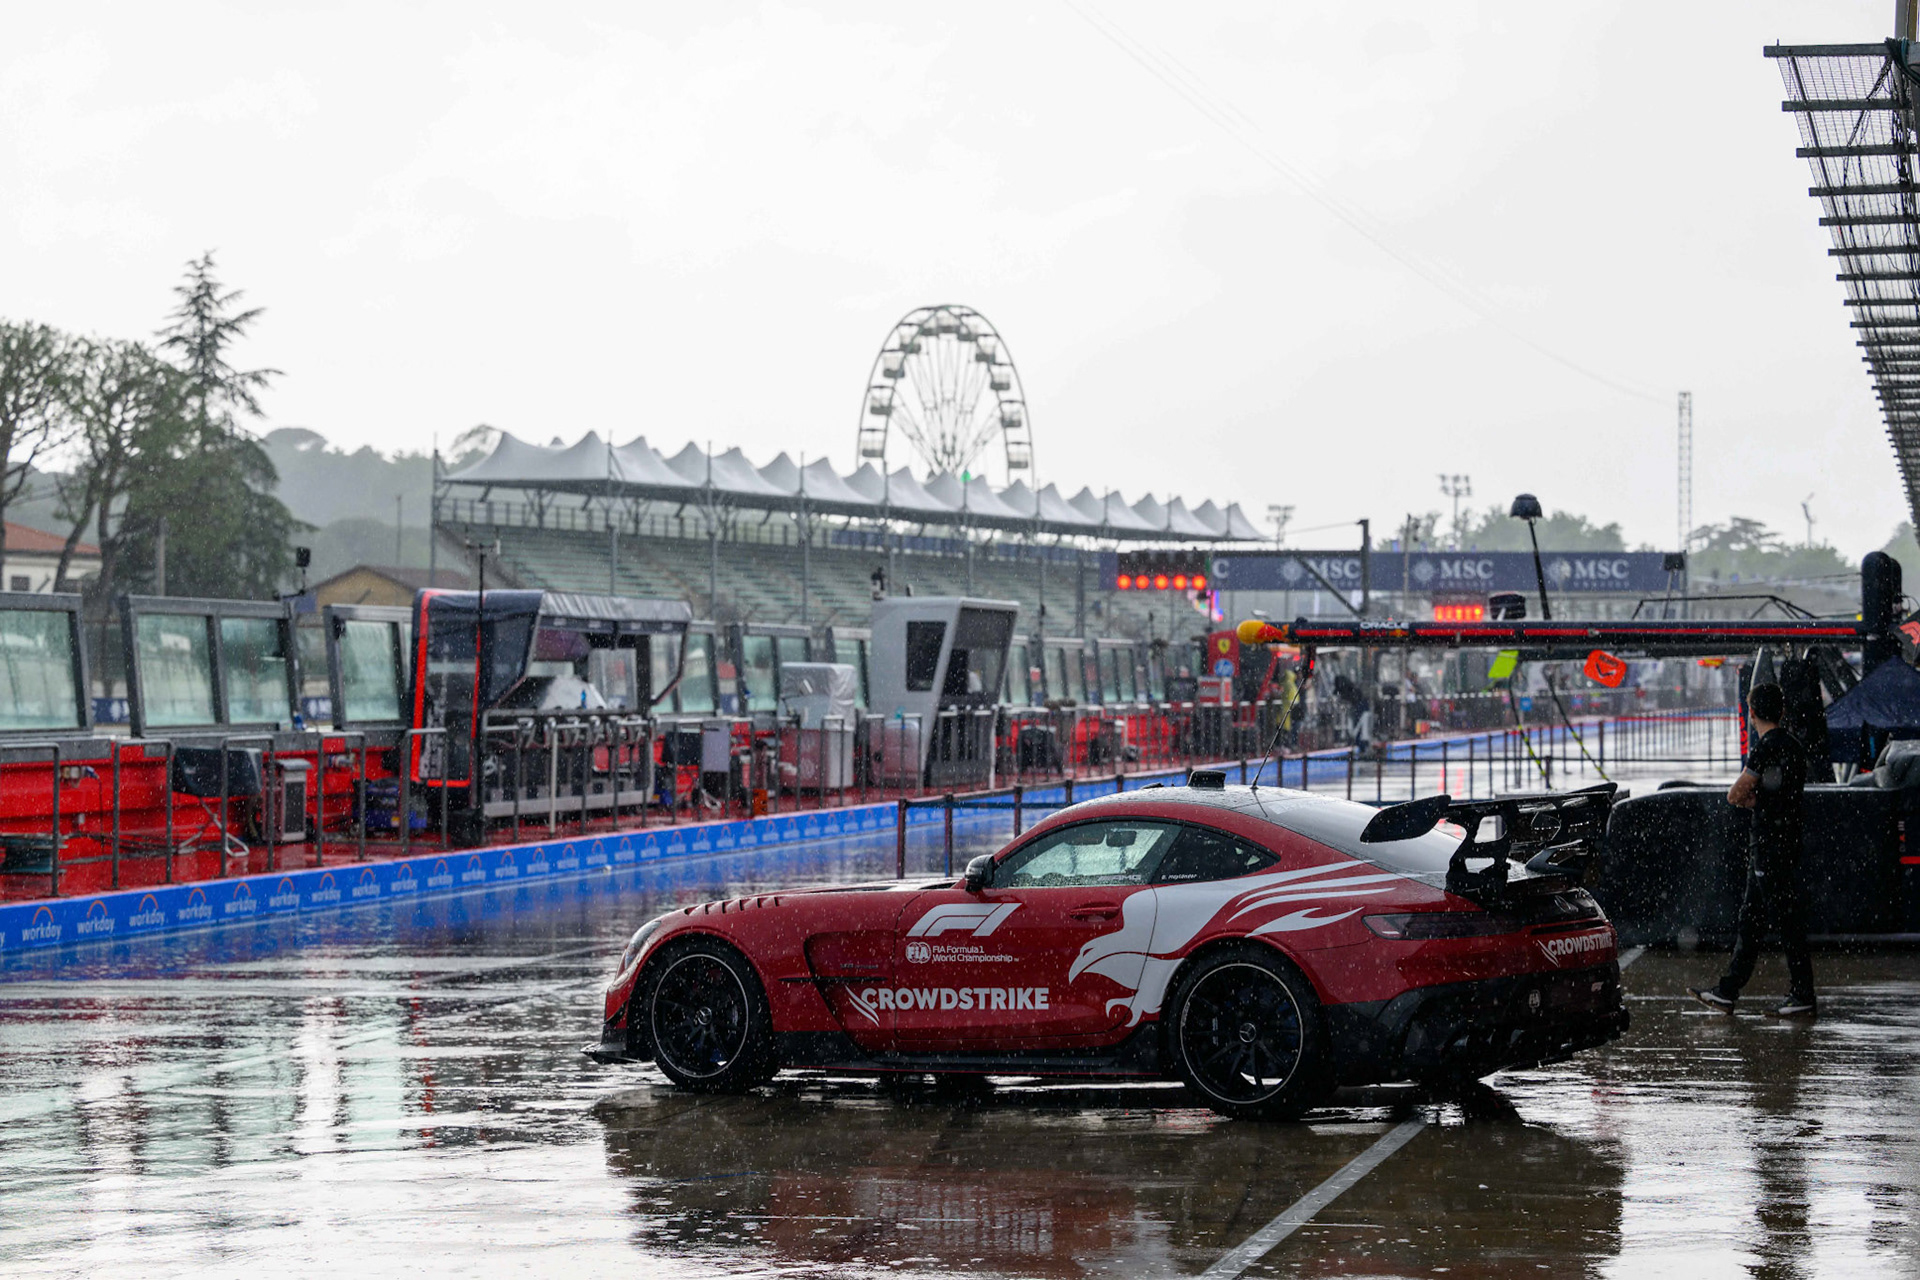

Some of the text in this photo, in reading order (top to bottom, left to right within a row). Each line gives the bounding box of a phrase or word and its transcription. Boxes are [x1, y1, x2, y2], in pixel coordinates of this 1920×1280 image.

[1308, 559, 1361, 579] MSC
[1440, 559, 1494, 579] MSC
[1575, 559, 1630, 579] MSC
[1360, 621, 1410, 630] ORACLE
[129, 904, 165, 926] workday
[177, 897, 213, 920] workday
[77, 915, 115, 934] workday
[906, 903, 1022, 936] F1
[22, 921, 62, 941] workday
[908, 945, 930, 960] FIA
[932, 945, 985, 954] FIA Formula 1
[1548, 932, 1613, 956] CROWDSTRIKE
[932, 954, 956, 963] World
[957, 953, 1013, 963] Championship
[861, 987, 1049, 1010] CROWDSTRIKE
